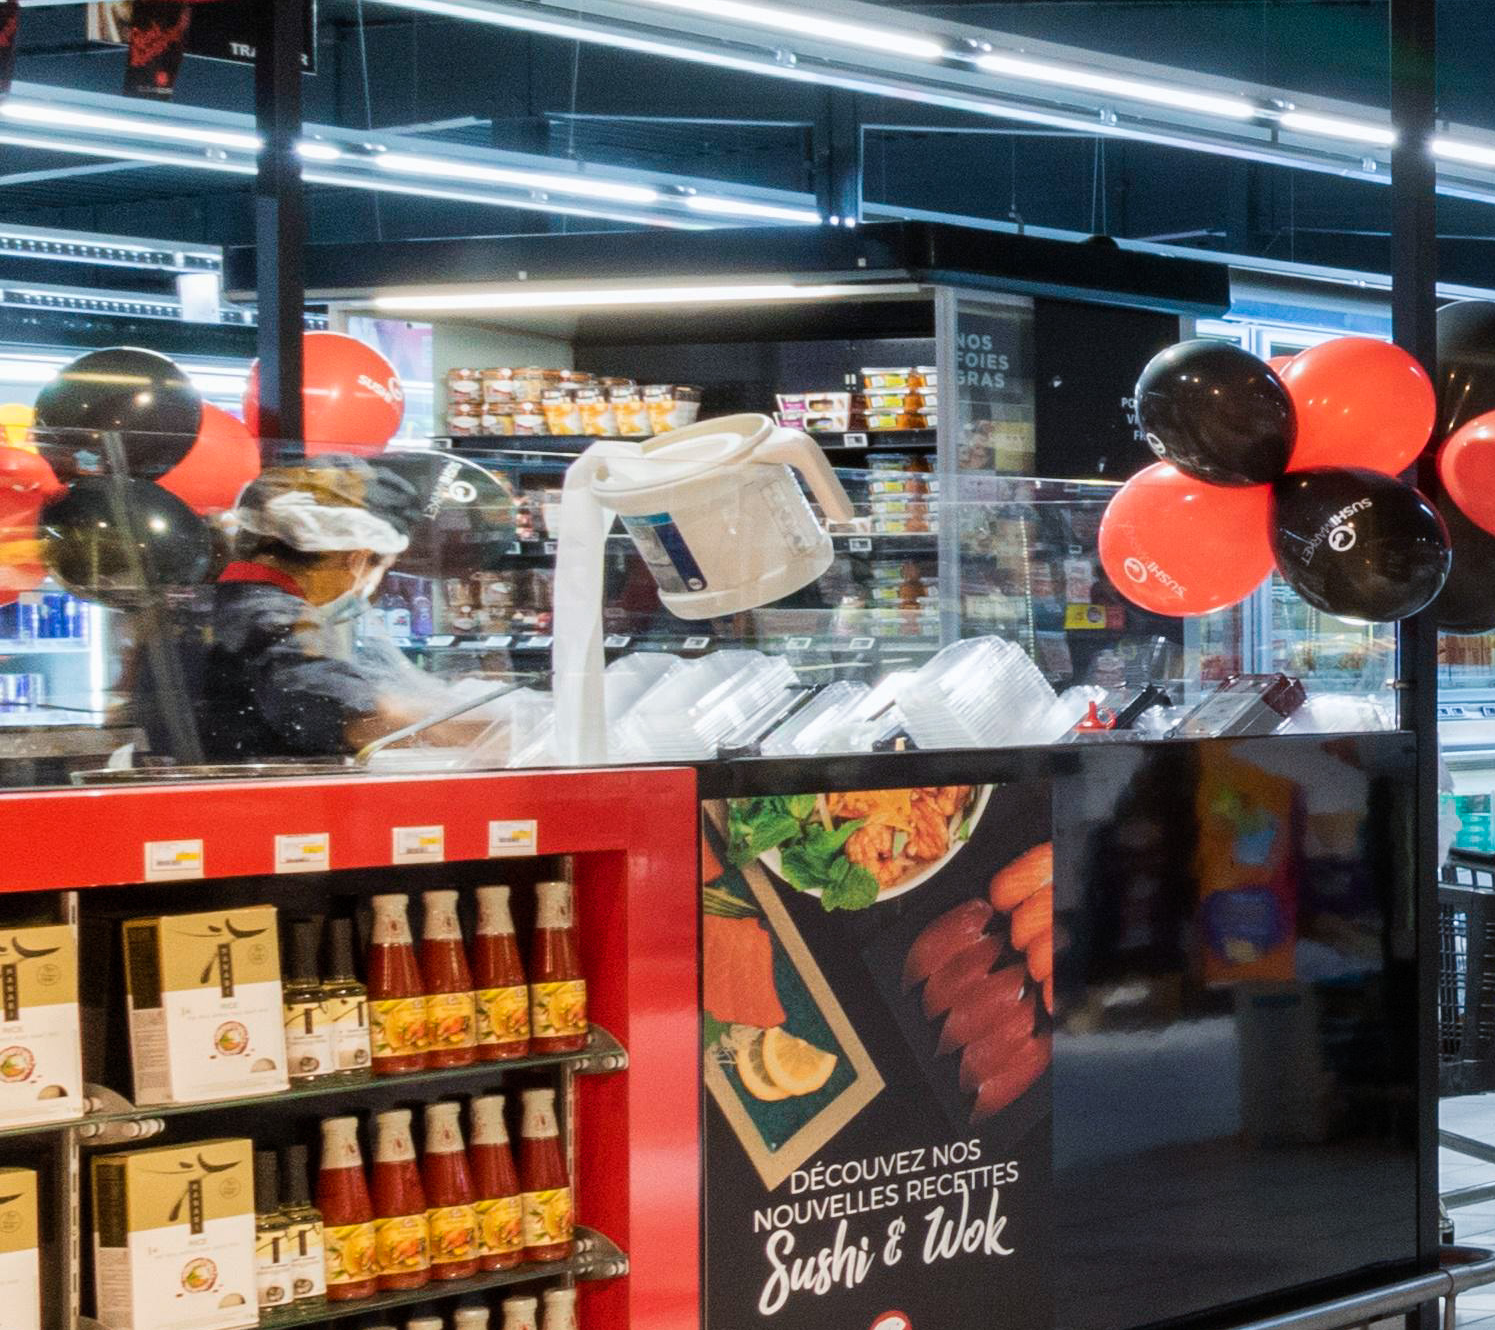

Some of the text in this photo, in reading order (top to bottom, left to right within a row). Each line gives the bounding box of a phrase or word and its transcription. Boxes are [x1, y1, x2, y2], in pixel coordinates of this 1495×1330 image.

[1330, 497, 1374, 528] SUSHI
[754, 1161, 1019, 1233] NOUVELLES RECETTES
[791, 1139, 981, 1194] DÉCOUVEZ NOS
[758, 1179, 1015, 1316] Sushi & Wok
